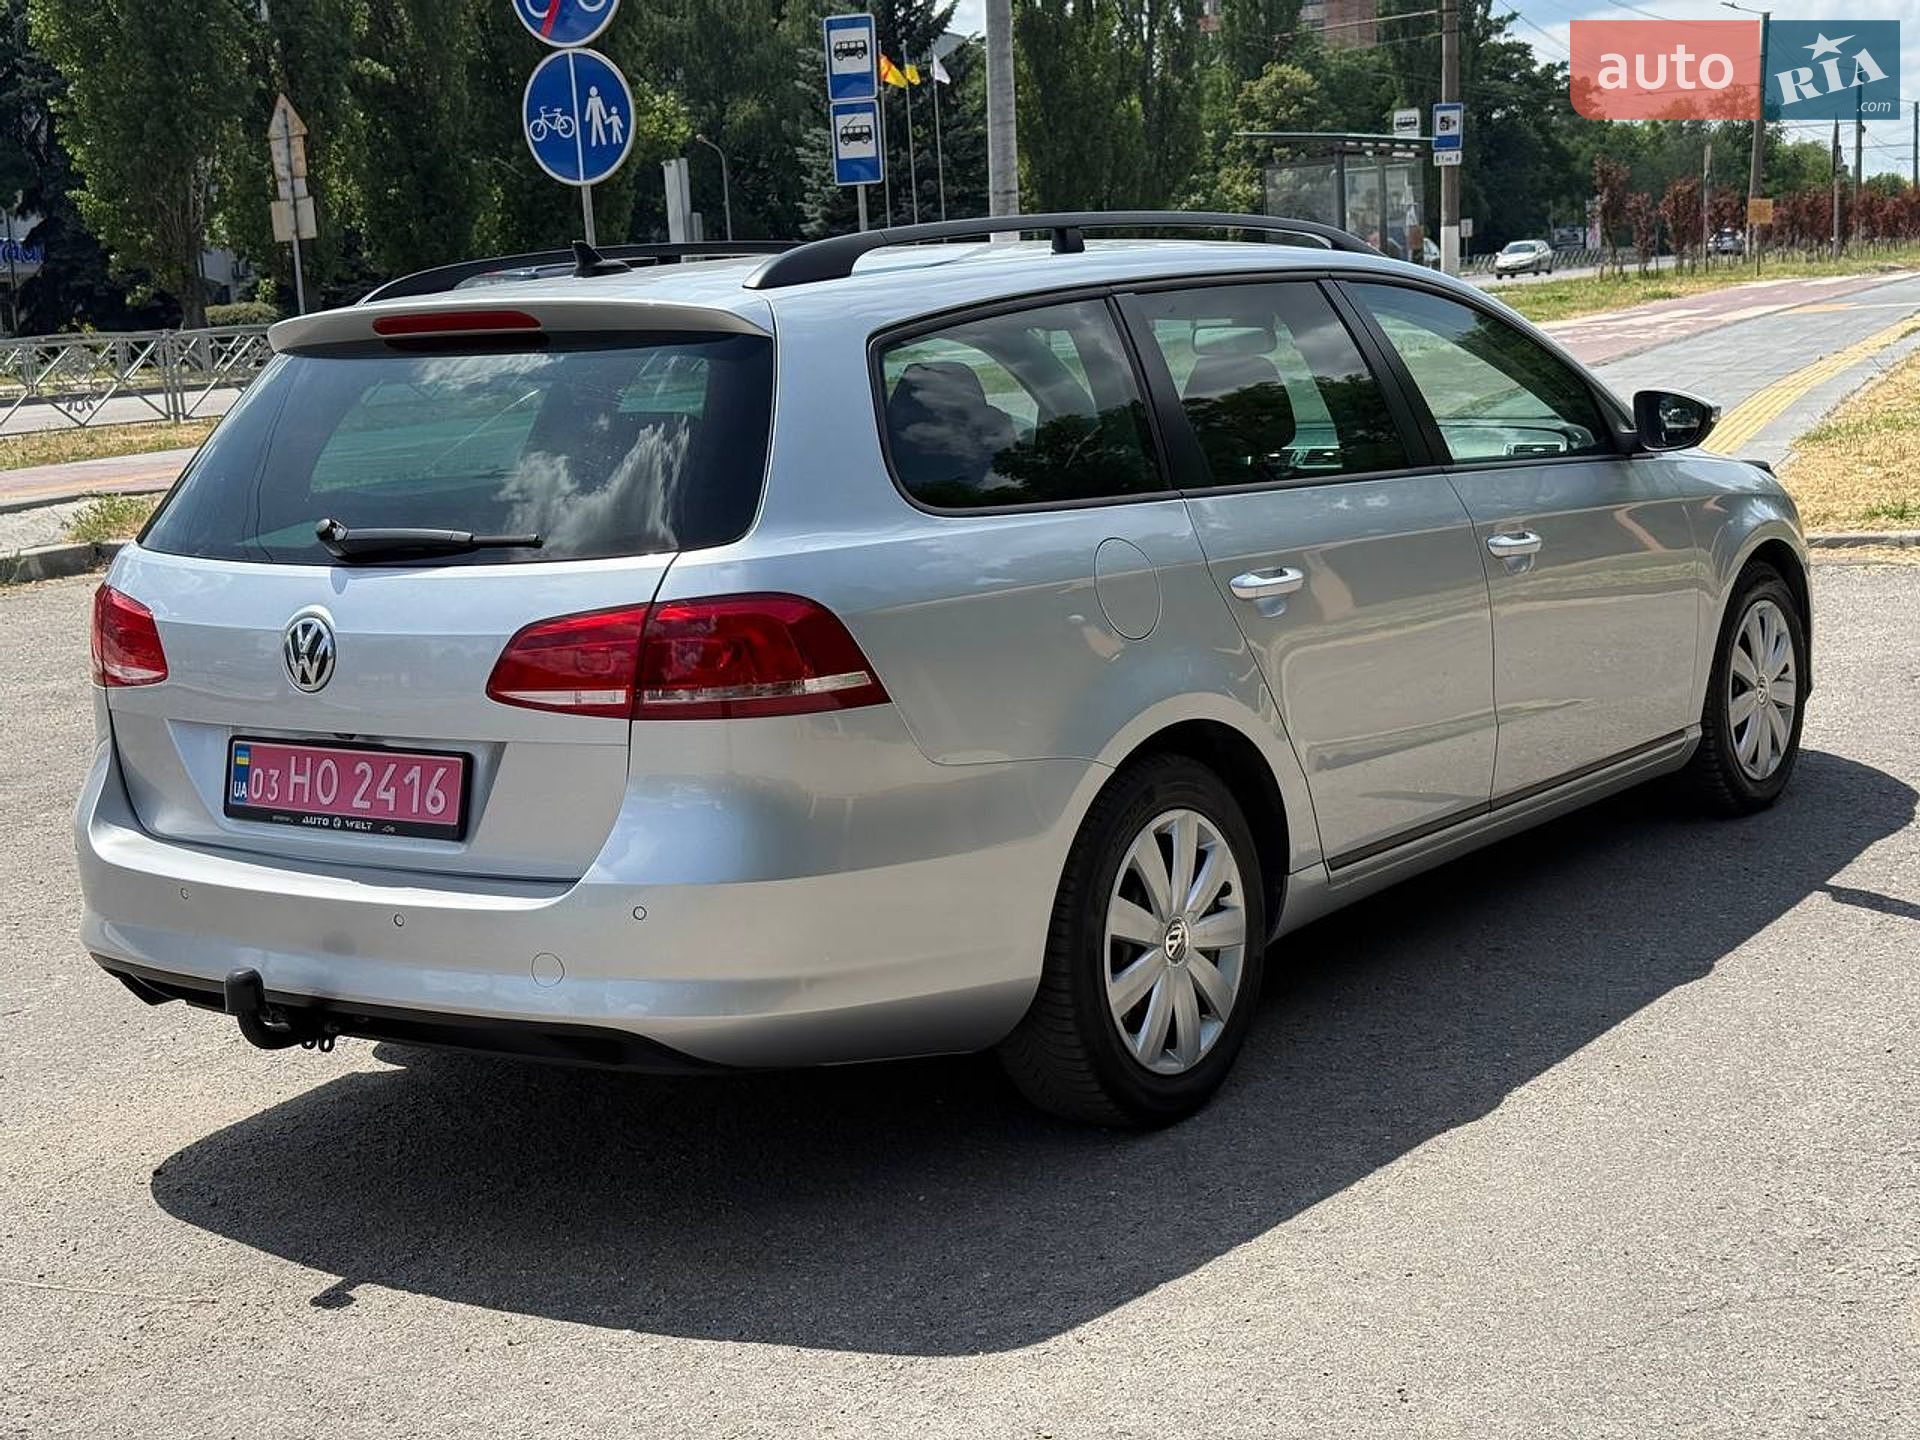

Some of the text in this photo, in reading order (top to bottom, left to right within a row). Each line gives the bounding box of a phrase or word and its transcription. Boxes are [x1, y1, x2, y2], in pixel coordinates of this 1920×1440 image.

[233, 780, 248, 798] UA
[250, 755, 447, 816] 03 HO 2416
[302, 815, 330, 827] AUTO
[345, 819, 374, 832] WELT
